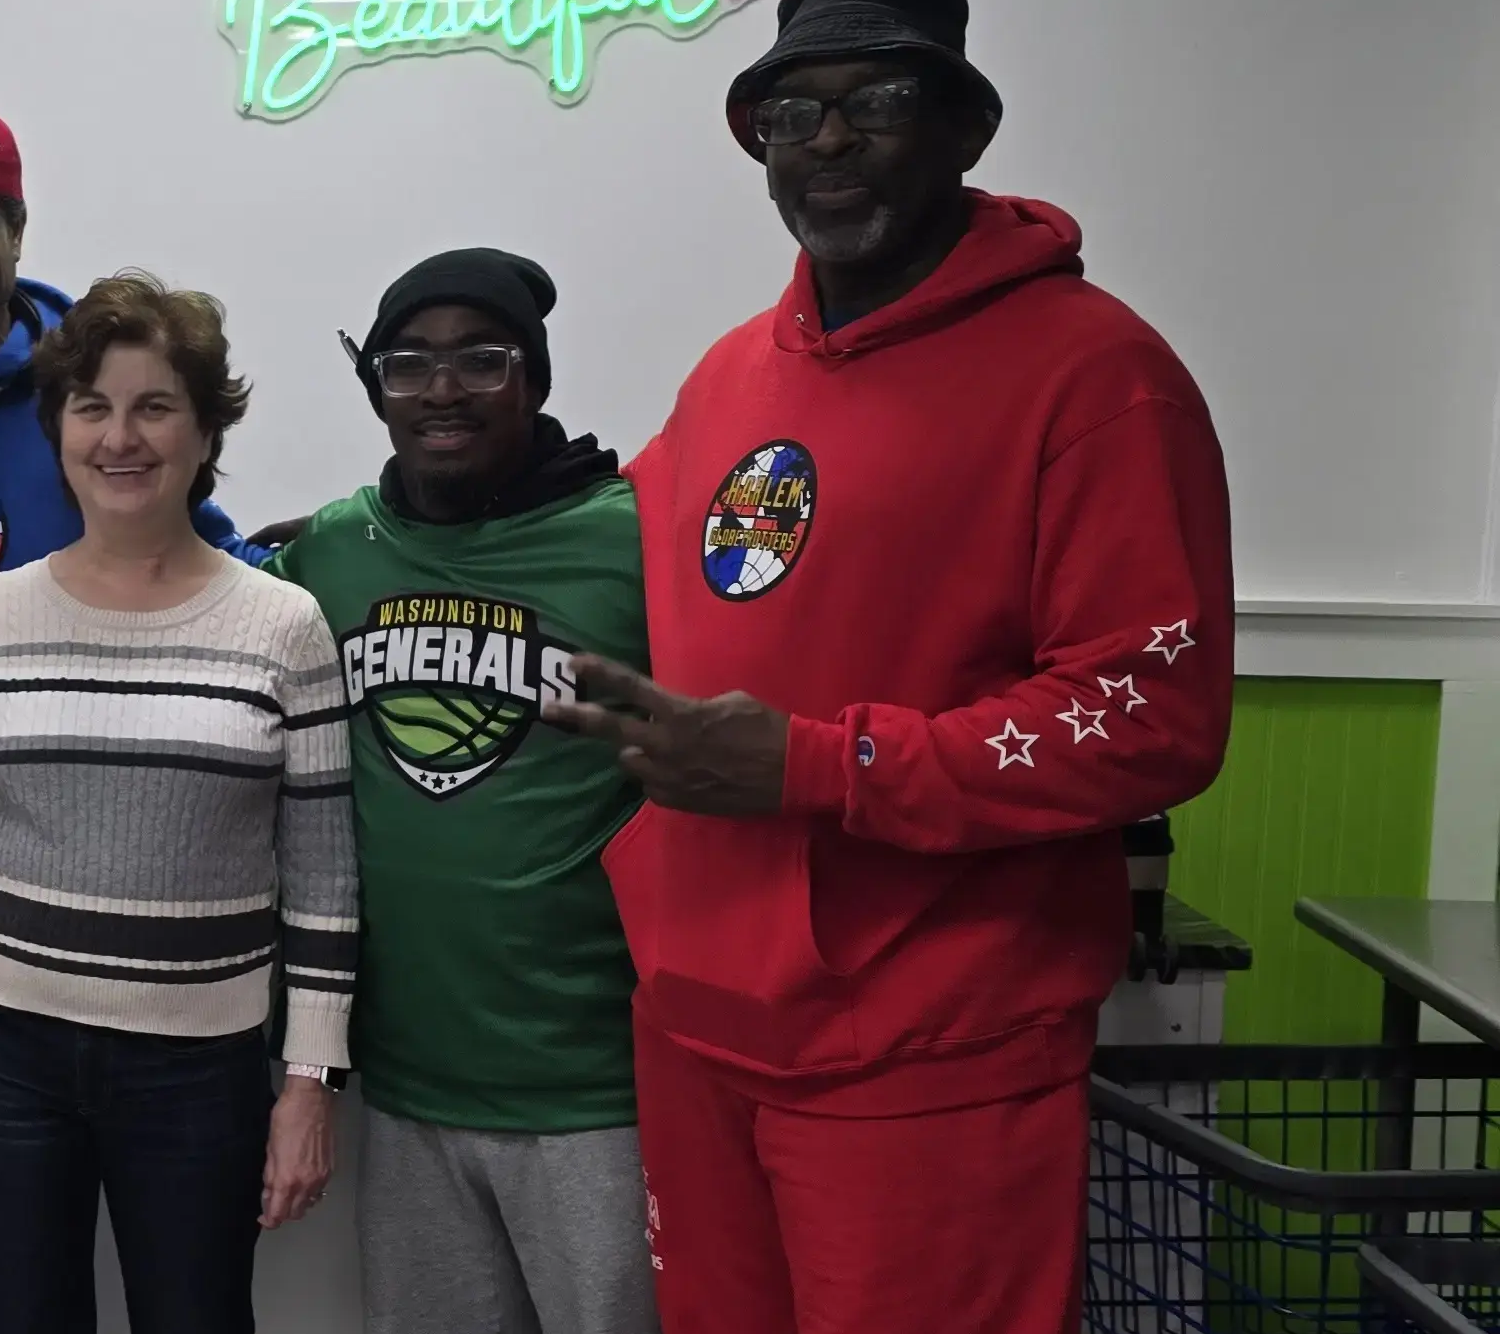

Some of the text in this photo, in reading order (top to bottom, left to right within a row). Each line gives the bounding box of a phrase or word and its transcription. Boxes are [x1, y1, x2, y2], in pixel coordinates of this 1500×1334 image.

[725, 474, 807, 509] HARLEM
[707, 526, 798, 553] GLOBETROTTERS
[378, 598, 524, 634] WASHINGTON
[342, 626, 577, 717] GENERALS
